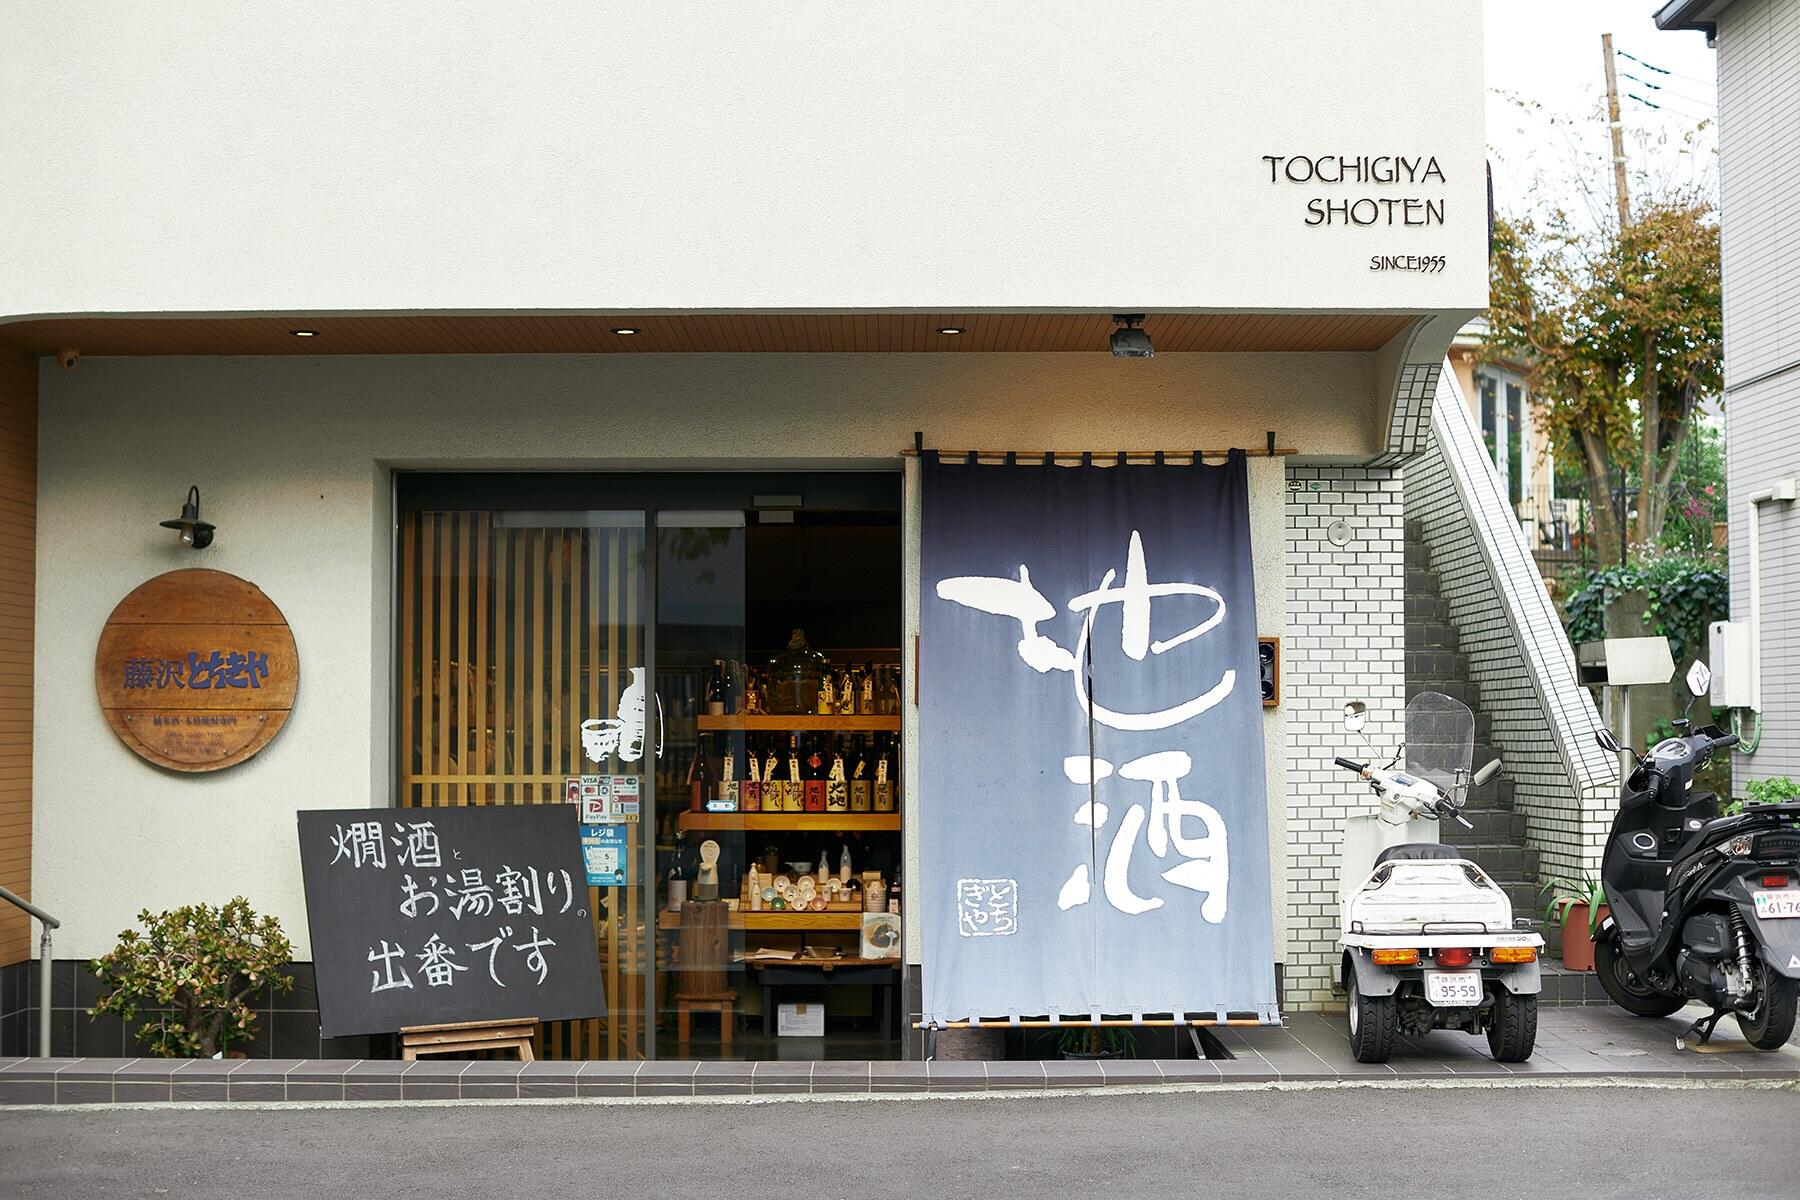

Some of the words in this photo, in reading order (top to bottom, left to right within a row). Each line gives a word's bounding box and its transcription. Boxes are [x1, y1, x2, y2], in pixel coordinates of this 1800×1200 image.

[1262, 155, 1446, 184] TOCHIGIYA
[1304, 198, 1445, 226] SHOTEN
[1369, 255, 1447, 273] SINCE1955
[936, 530, 1236, 924] 地酒
[368, 926, 556, 993] 出番です
[1441, 985, 1476, 997] 95-59
